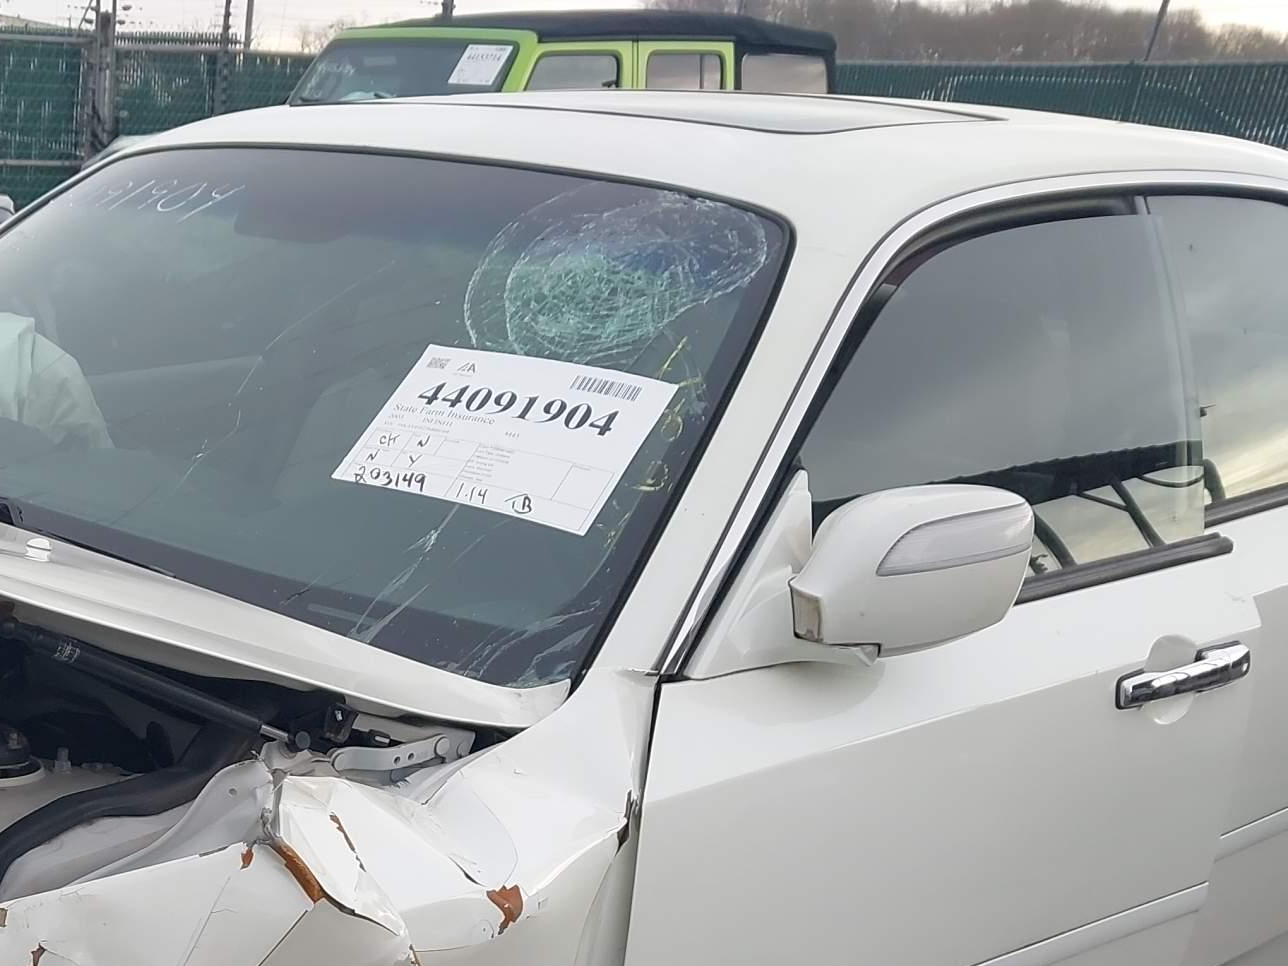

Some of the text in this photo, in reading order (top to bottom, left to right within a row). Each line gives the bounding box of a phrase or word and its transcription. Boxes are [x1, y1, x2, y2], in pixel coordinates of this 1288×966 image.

[417, 381, 620, 437] 44091904
[419, 406, 445, 417] Farm
[447, 411, 496, 425] Insurance
[408, 454, 423, 467] Y
[353, 465, 426, 492] 203149
